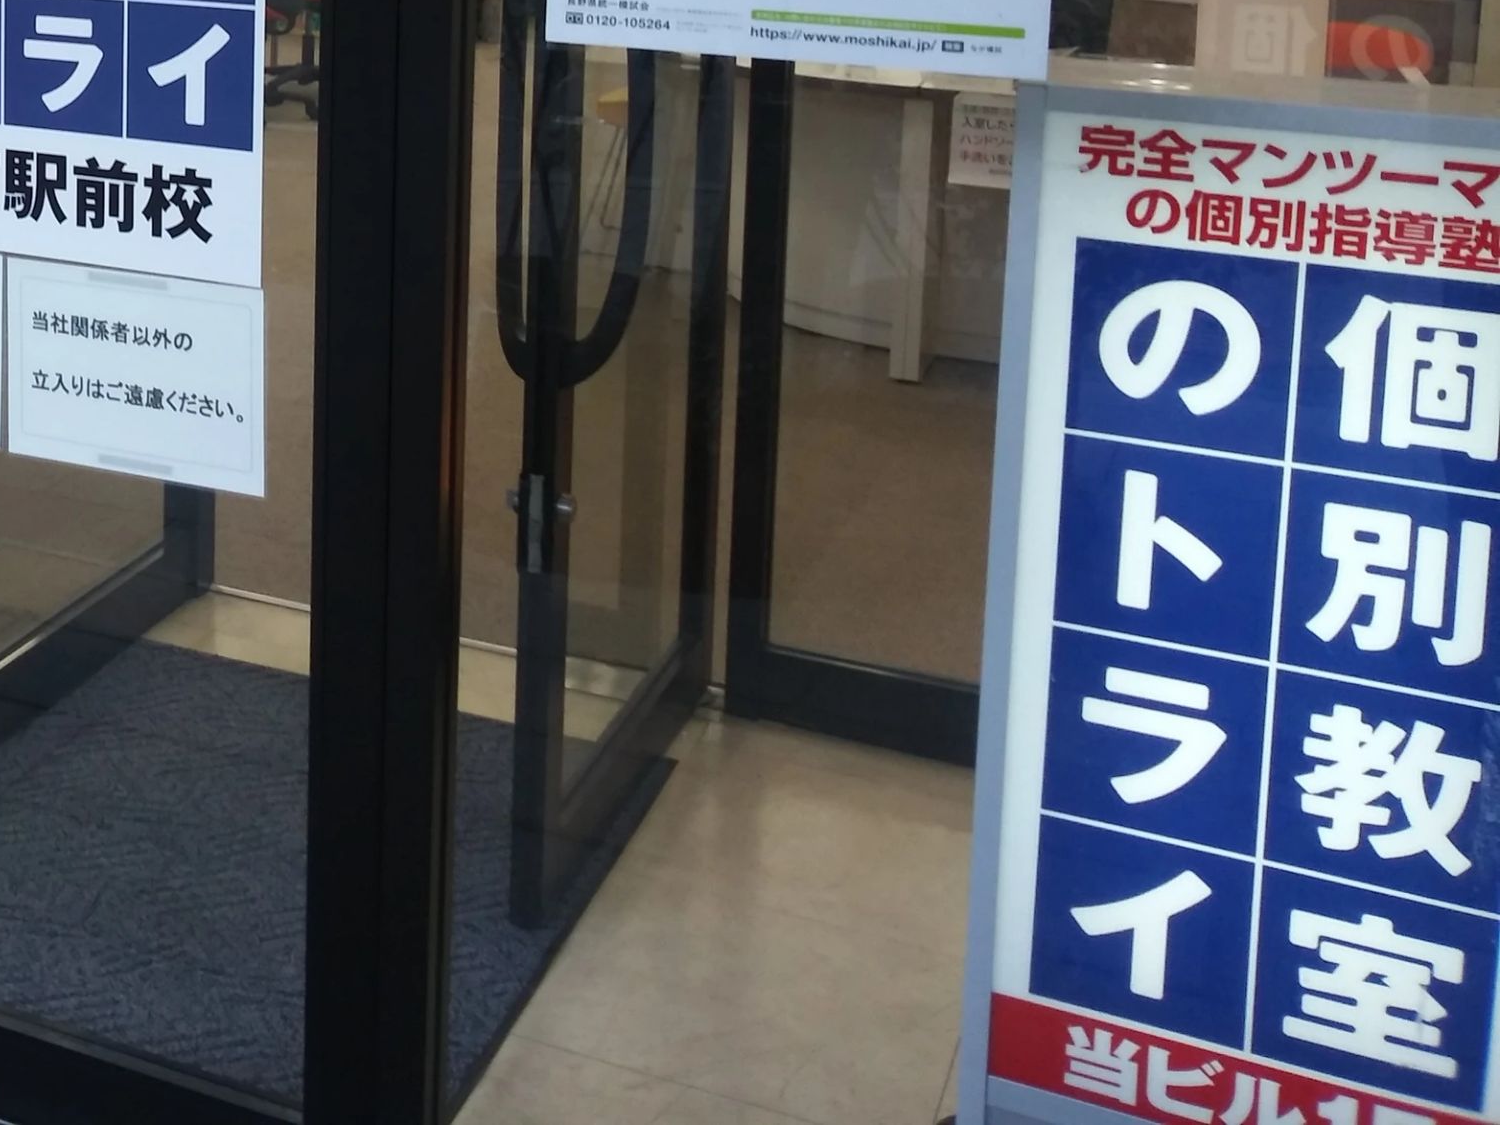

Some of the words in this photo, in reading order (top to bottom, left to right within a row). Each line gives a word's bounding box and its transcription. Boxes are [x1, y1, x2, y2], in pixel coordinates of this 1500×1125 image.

[586, 12, 671, 31] 0120-105264
[750, 26, 937, 53] https://www.moshikai.jp/
[1077, 124, 1500, 209] 完全マンツーマ
[1124, 188, 1500, 274] の個別指導塾
[31, 309, 194, 352] 当社関係者以外の
[31, 368, 244, 424] 立入りはご遠慮ください。
[1069, 279, 1262, 1001] のトライ
[1282, 293, 1500, 1079] 個別教室
